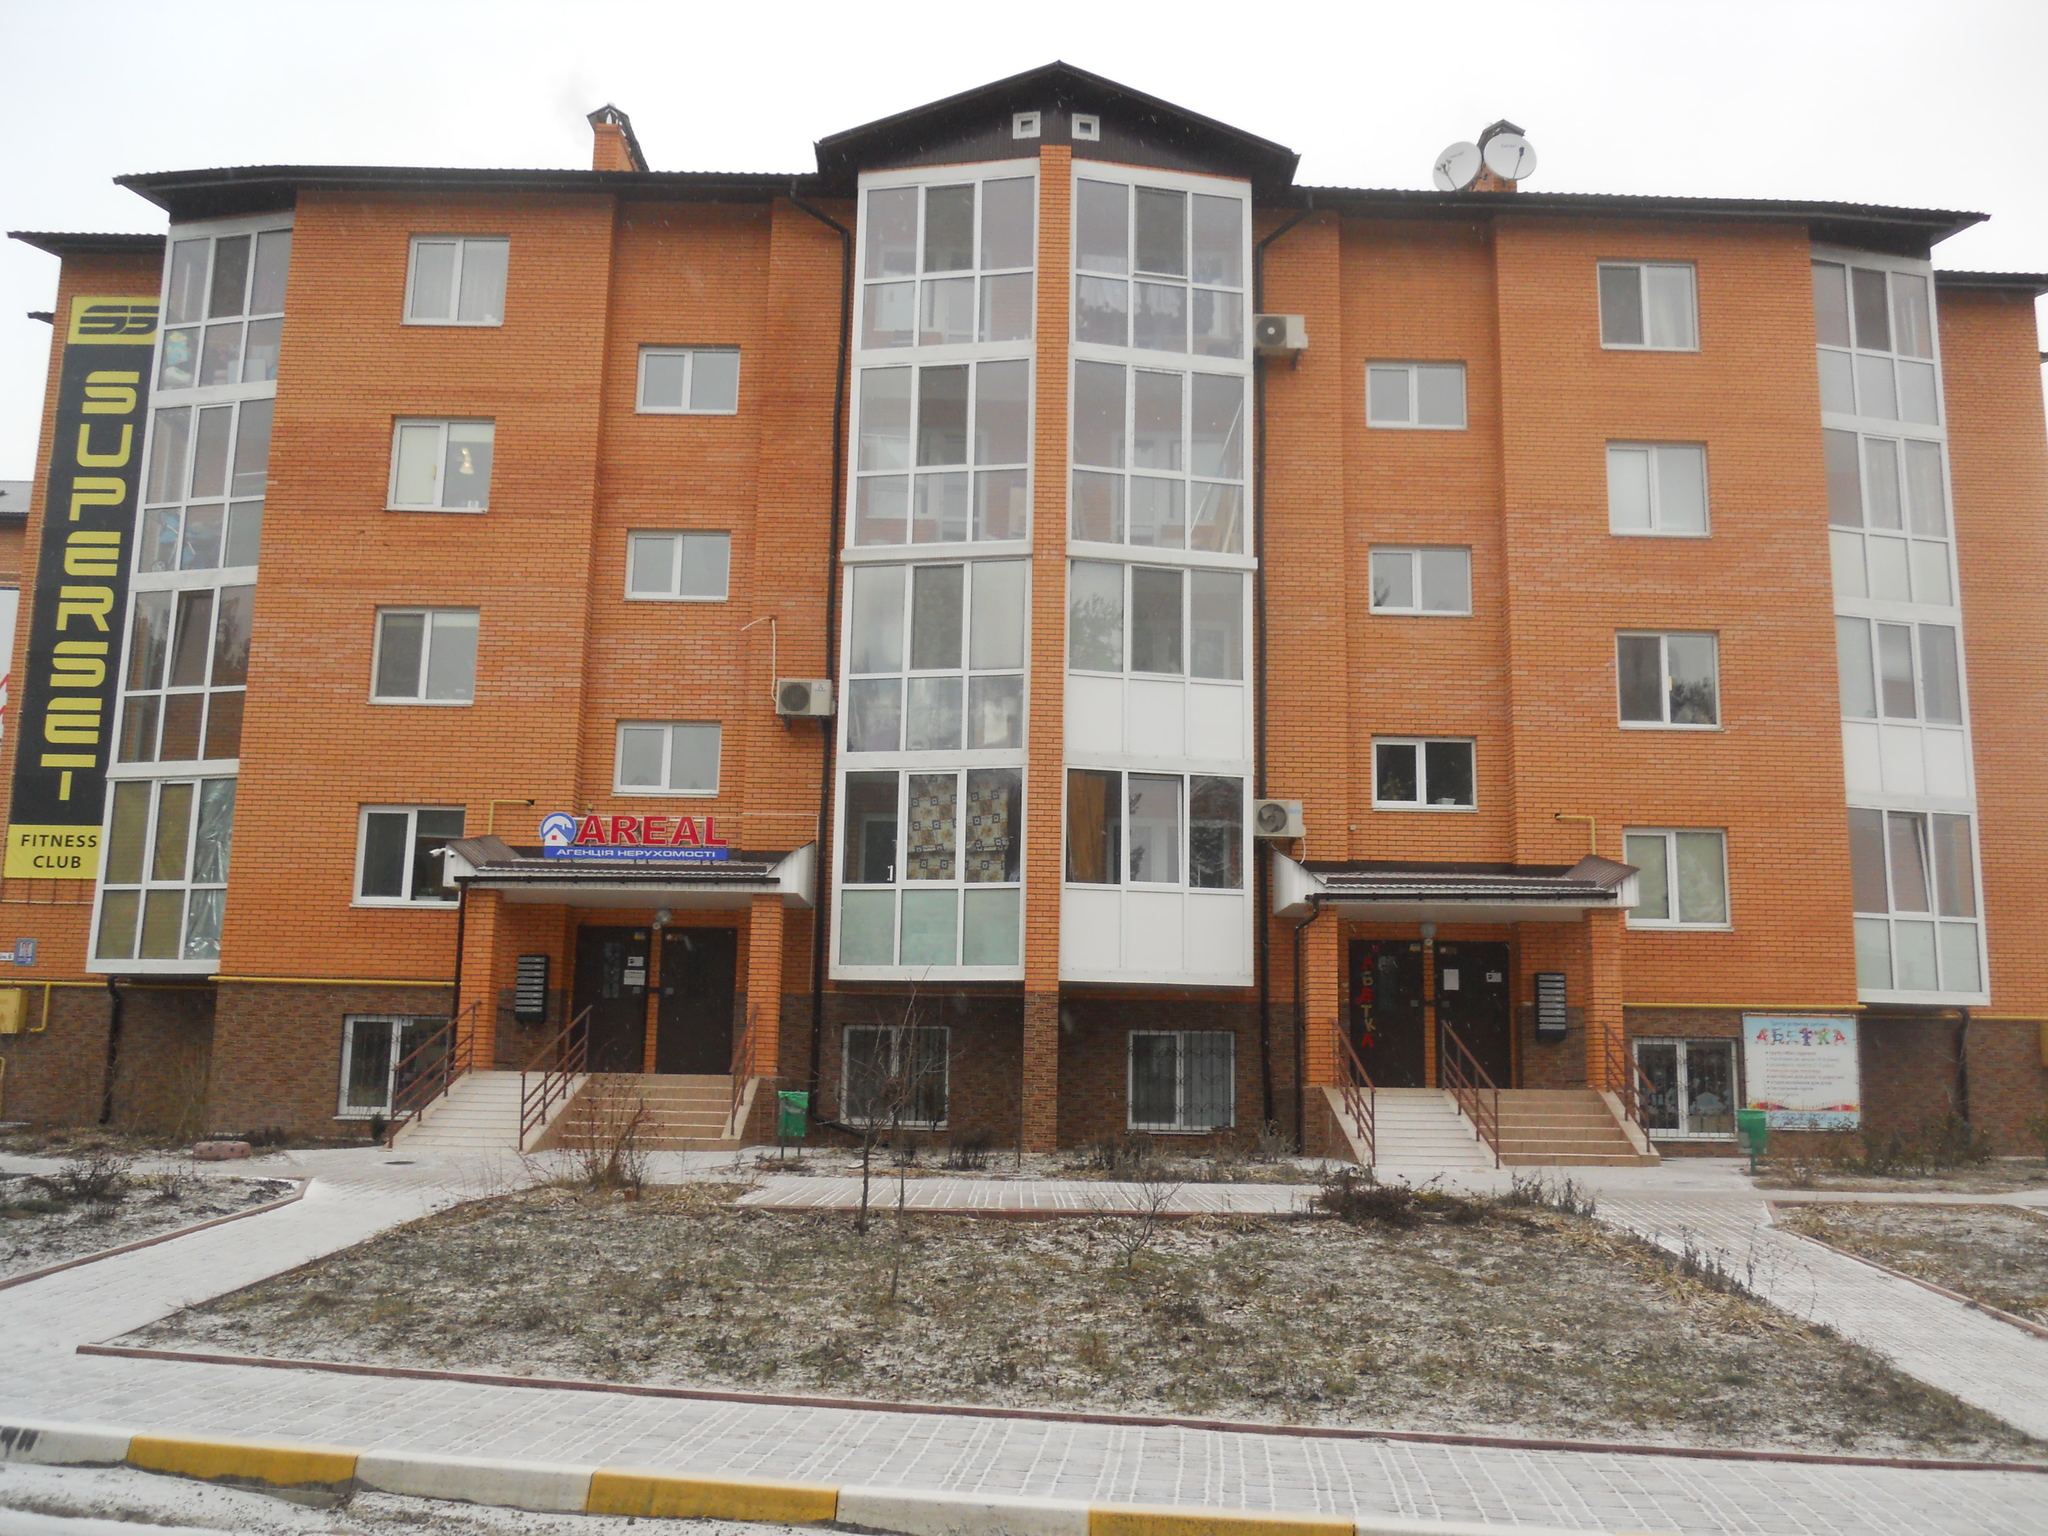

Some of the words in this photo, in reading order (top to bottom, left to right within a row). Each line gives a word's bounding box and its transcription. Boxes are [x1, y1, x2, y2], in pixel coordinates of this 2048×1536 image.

[40, 370, 140, 801] SUPERSET
[574, 815, 729, 846] AREAL
[21, 834, 98, 848] FITNESS
[556, 848, 614, 858] АГЕНЦІЯ
[617, 849, 716, 859] НЕРУХОМОСТІ
[33, 855, 82, 868] CLUB
